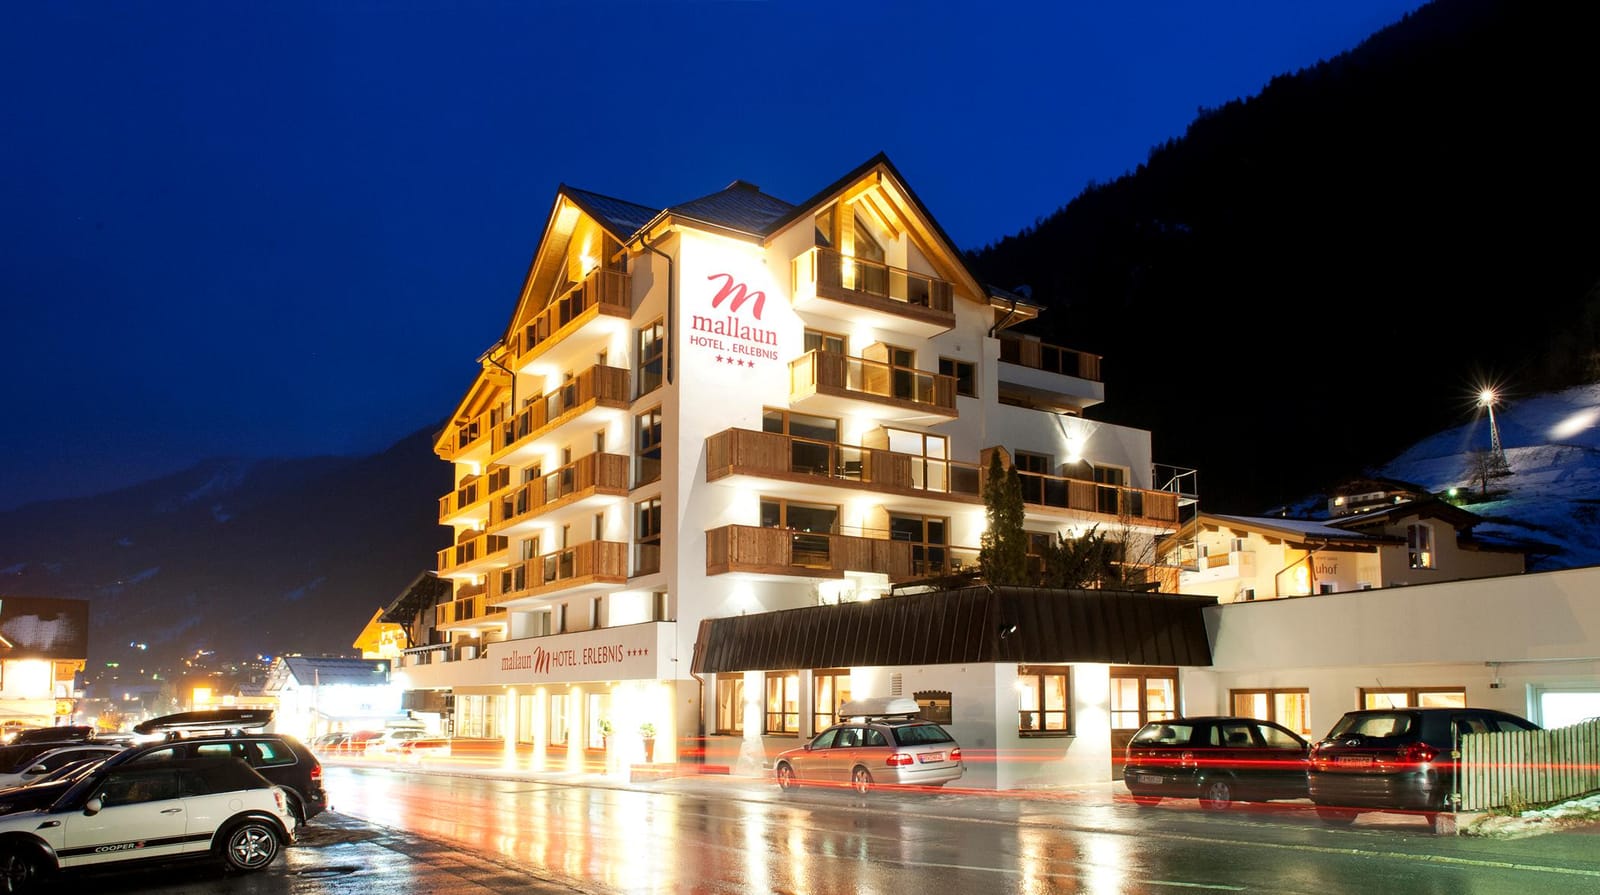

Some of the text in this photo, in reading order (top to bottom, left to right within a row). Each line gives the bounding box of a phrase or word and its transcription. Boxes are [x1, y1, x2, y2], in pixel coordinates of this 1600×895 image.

[692, 315, 778, 345] mallaun
[690, 335, 724, 350] HOTEL
[732, 343, 778, 360] ERLEBNIS
[1314, 563, 1338, 575] uhof
[501, 651, 532, 671] mallaun
[552, 650, 577, 667] HOTEL
[583, 644, 623, 664] ERLEBNIS
[95, 843, 135, 853] COOPER
